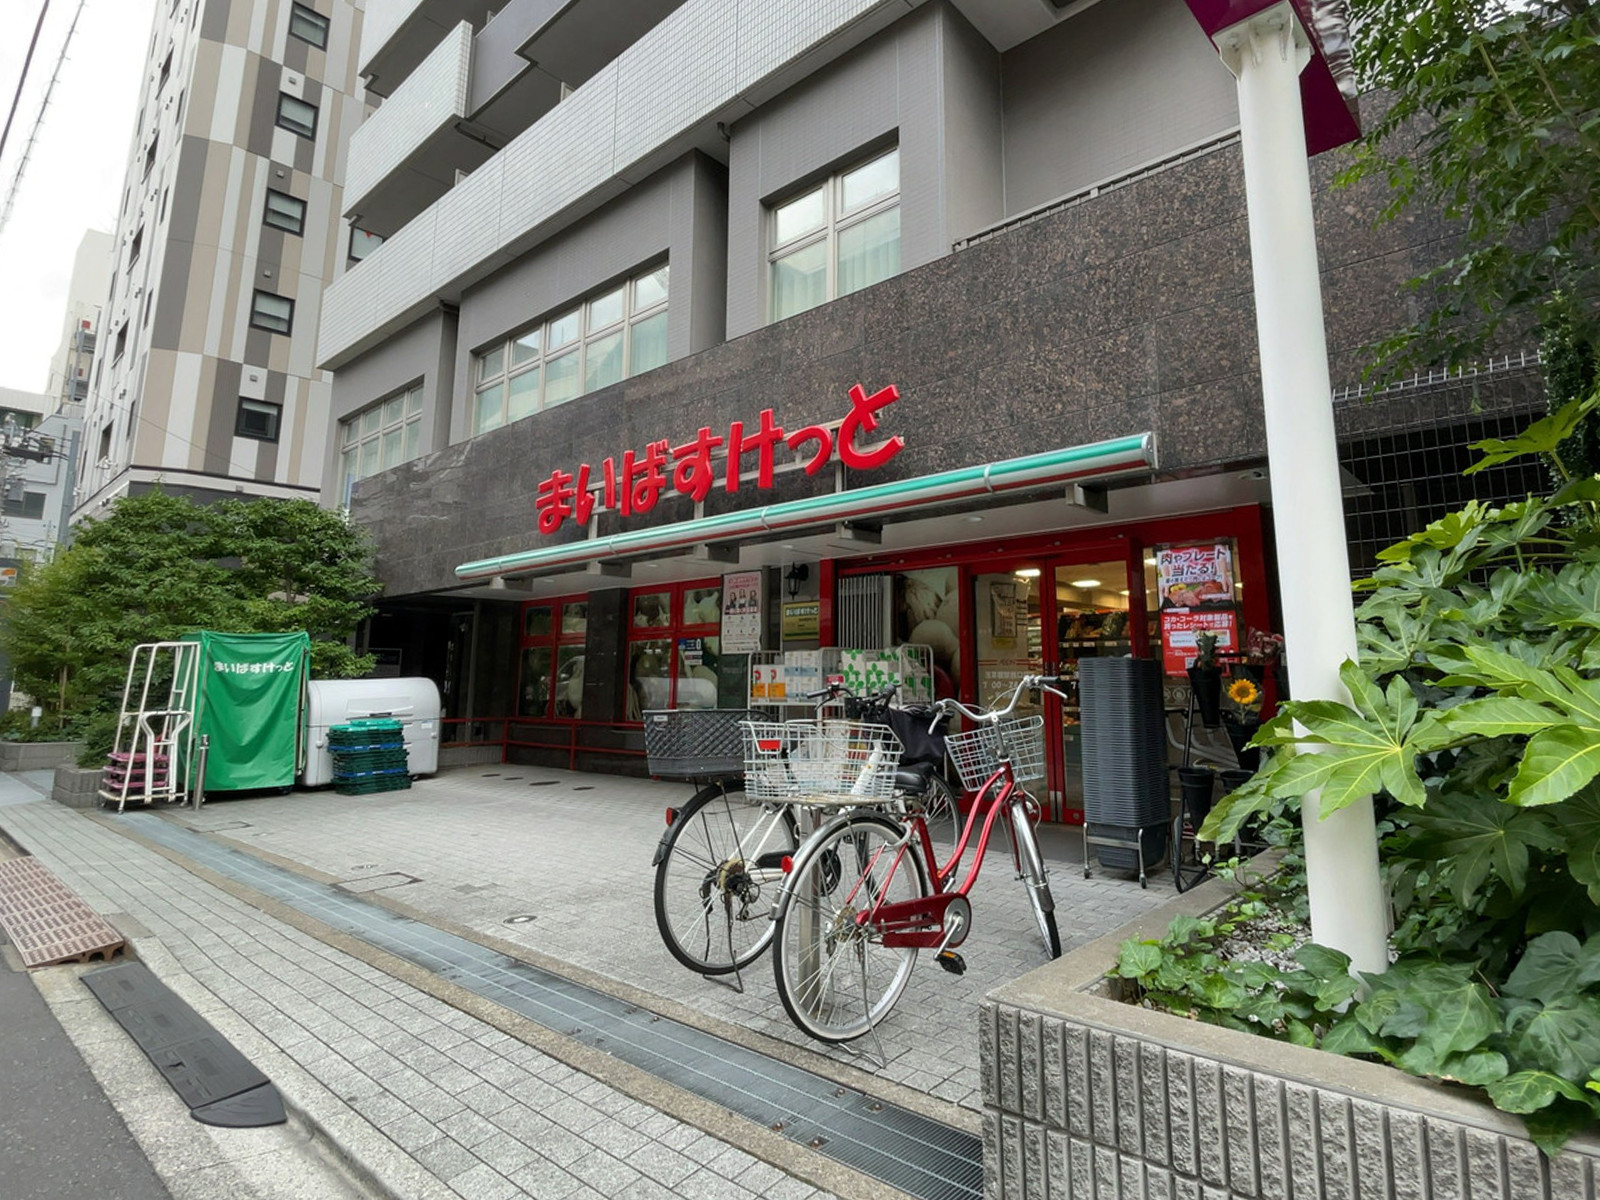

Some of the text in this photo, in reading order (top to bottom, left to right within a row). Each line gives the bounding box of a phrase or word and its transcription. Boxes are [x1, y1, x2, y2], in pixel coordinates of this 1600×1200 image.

[535, 383, 905, 535] まいばすけっと
[1160, 548, 1226, 565] 肉やプレート
[214, 660, 294, 675] まいばすけっと
